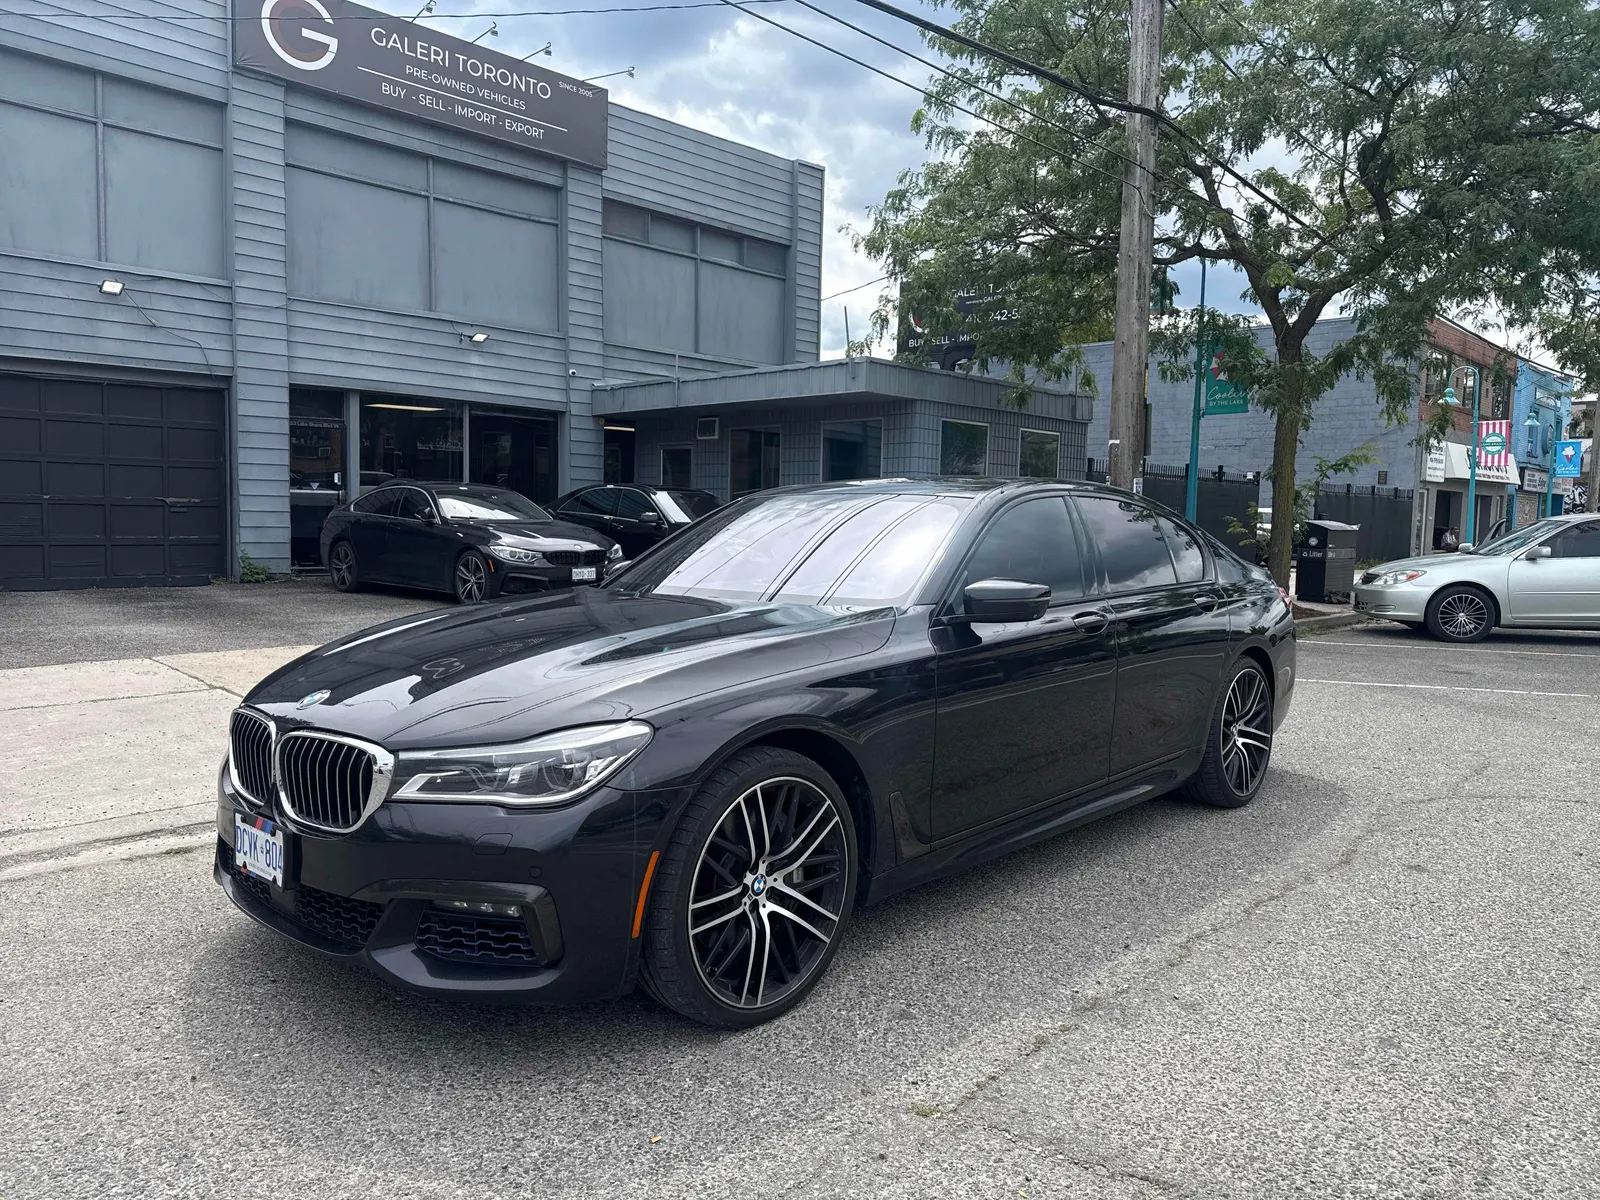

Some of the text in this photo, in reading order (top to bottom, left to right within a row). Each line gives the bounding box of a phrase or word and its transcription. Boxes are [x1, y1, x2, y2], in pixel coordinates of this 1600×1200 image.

[370, 27, 551, 99] GALERI TORONTO
[405, 65, 526, 110] PRE-OWNED VEHICLES
[558, 81, 593, 98] SINCE 2005
[381, 82, 407, 99] BUY
[418, 93, 446, 111] SELL
[455, 104, 497, 125] IMPORT
[505, 119, 545, 140] EXPORT
[931, 335, 950, 345] SELL
[1309, 550, 1324, 558] Litter
[235, 825, 283, 874] DCVK 804
